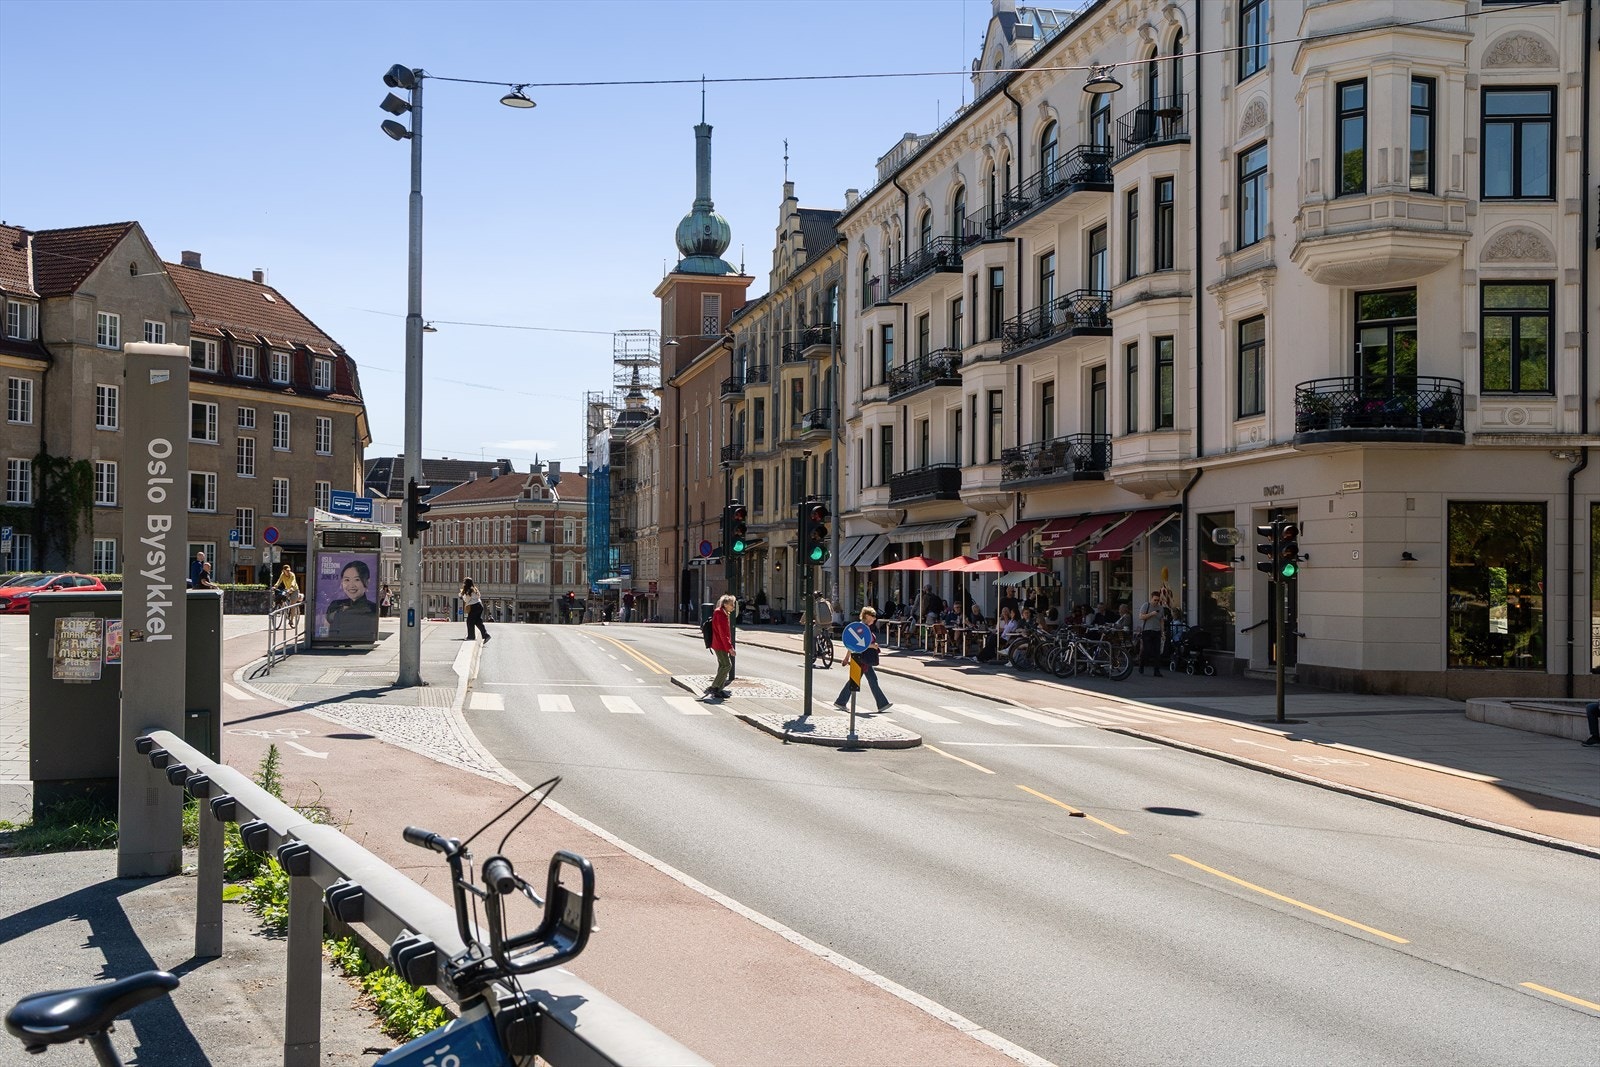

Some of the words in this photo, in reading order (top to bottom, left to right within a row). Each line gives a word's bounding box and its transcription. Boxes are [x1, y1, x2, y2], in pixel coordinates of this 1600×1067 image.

[147, 437, 174, 503] Oslo
[140, 514, 173, 643] Bysykkel
[61, 620, 97, 630] LOPPE
